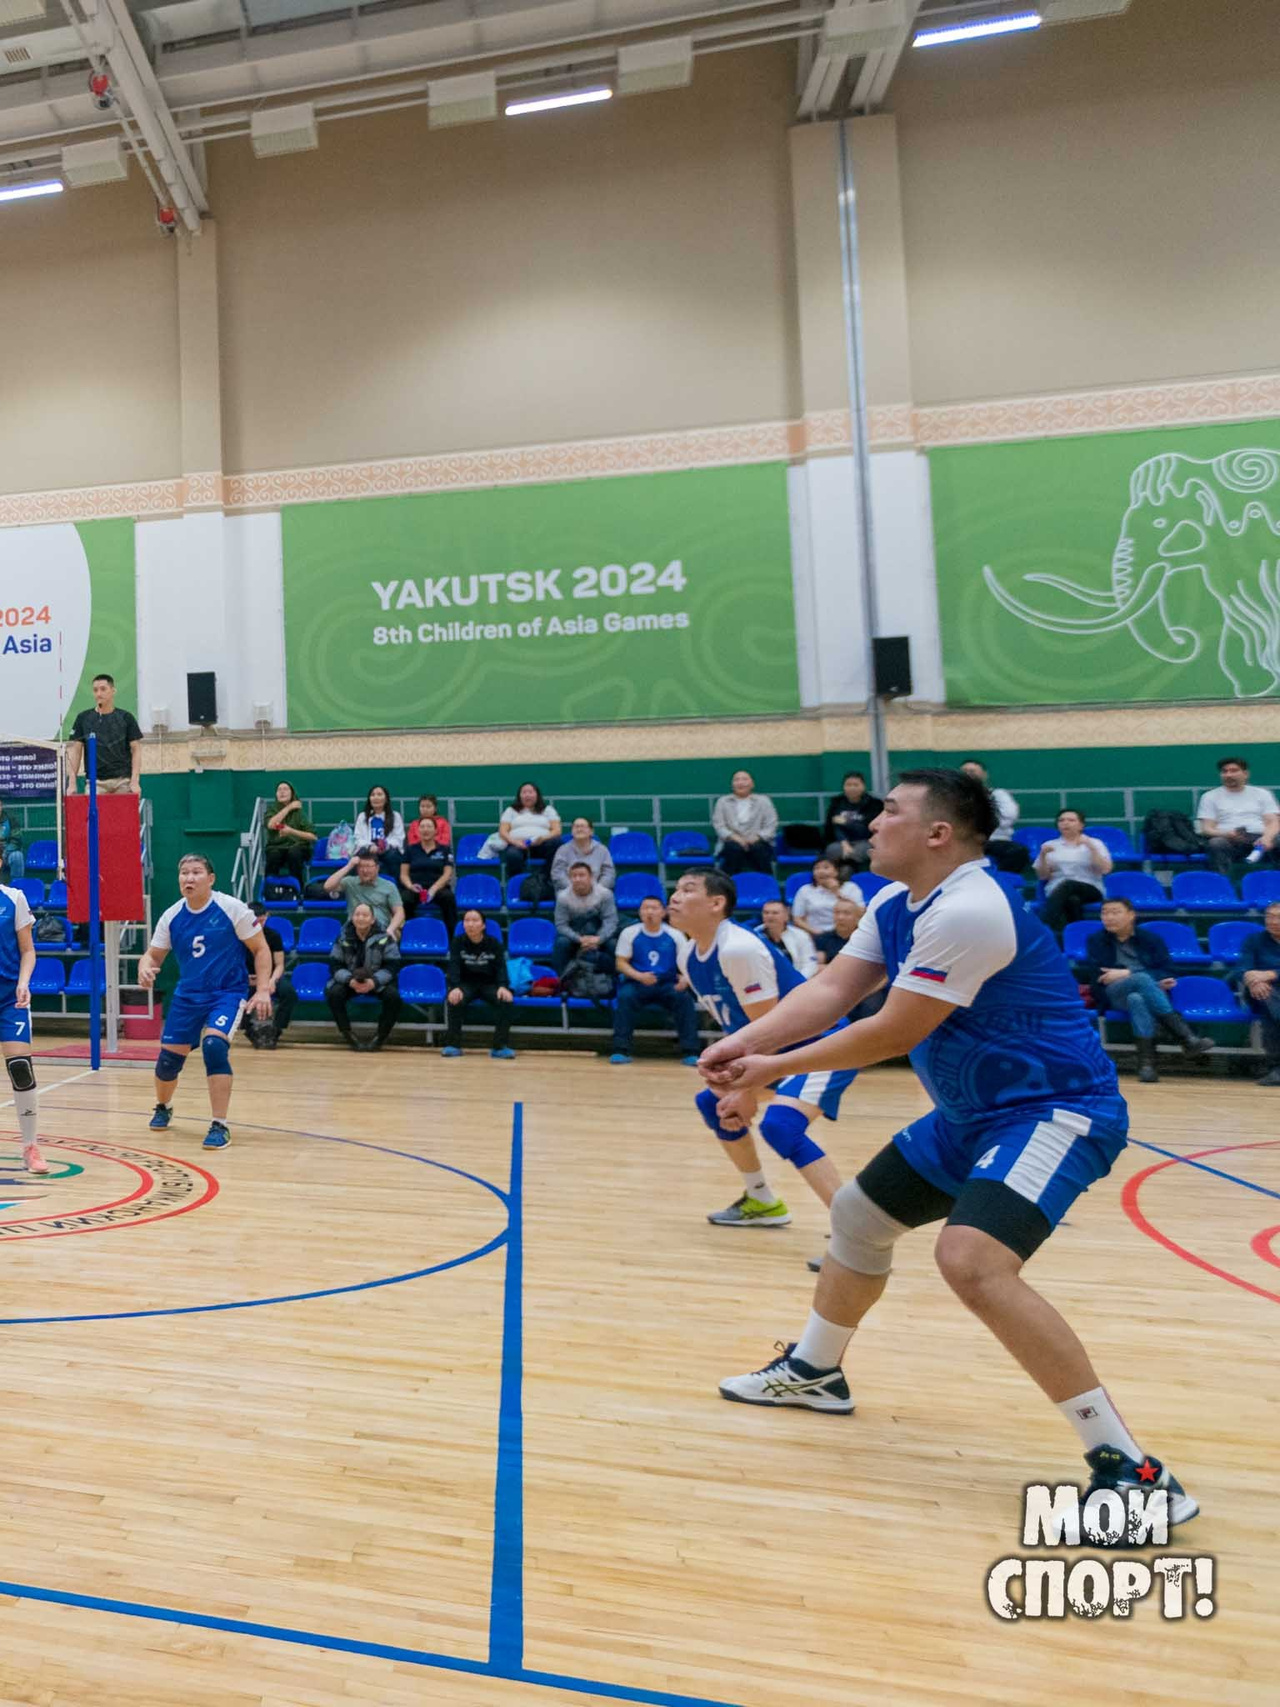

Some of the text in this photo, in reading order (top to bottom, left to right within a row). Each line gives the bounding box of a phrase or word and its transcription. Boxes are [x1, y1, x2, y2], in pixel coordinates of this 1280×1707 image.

[372, 560, 687, 611] YAKUTSK 2024
[373, 611, 690, 646] 8th Children of Asia Games
[3, 634, 52, 655] Asia
[192, 935, 206, 958] 5
[648, 950, 660, 966] 9
[15, 1022, 26, 1036] 7
[215, 1015, 229, 1027] 5
[975, 1145, 1000, 1169] 4
